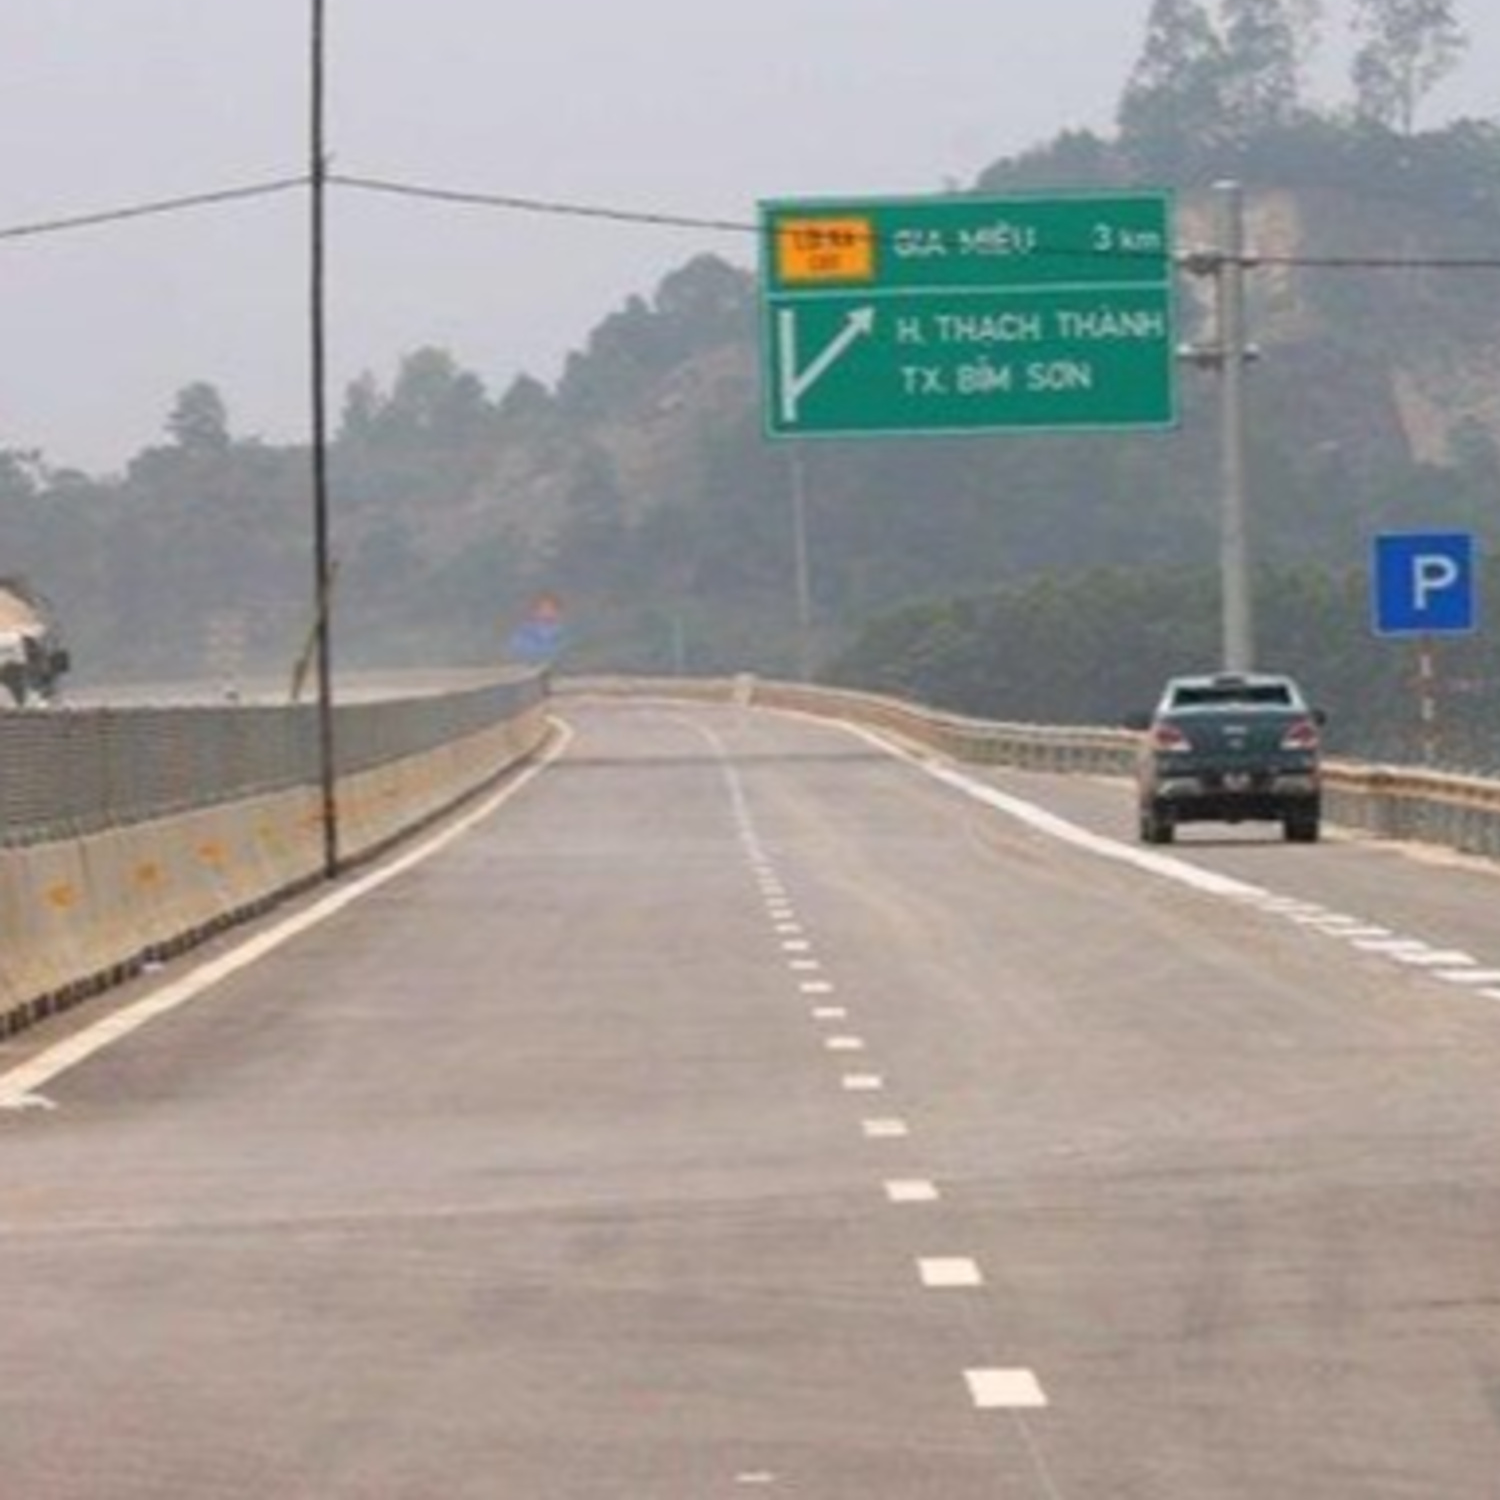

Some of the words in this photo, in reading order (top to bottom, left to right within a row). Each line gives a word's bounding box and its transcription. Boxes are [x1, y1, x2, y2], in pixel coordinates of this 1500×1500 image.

[1093, 223, 1112, 251] 3
[1120, 226, 1161, 251] km
[1412, 554, 1458, 611] P
